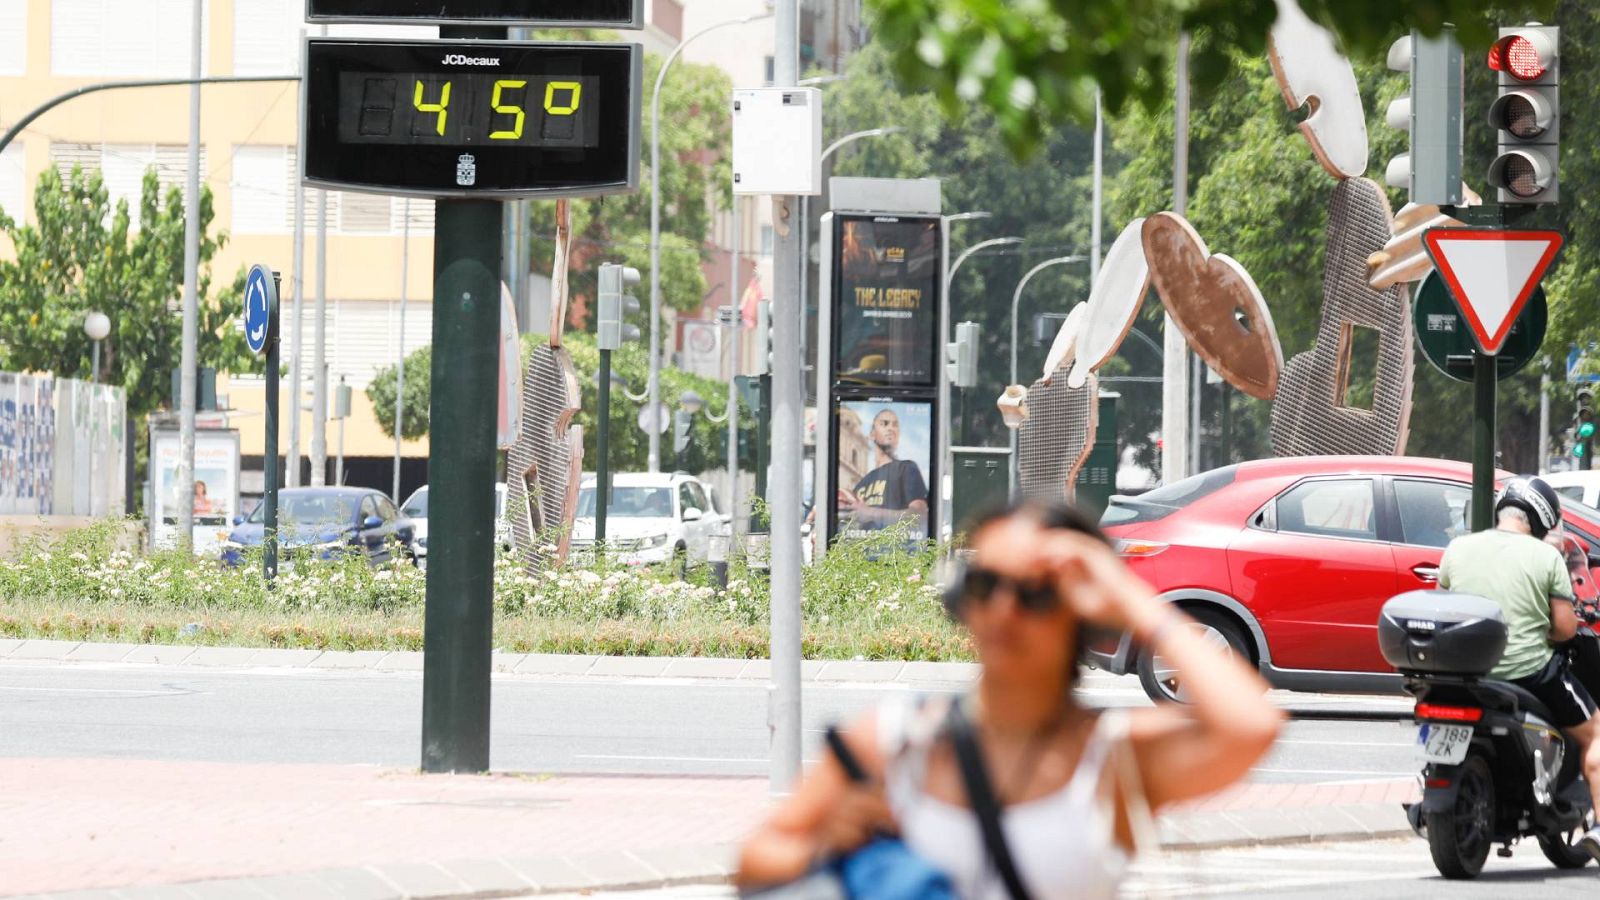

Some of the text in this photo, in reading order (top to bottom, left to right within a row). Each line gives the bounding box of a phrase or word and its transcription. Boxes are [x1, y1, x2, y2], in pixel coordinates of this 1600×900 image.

[441, 54, 500, 66] JCDecaux
[855, 287, 921, 309] THE LEGACY
[1429, 725, 1469, 743] 7189
